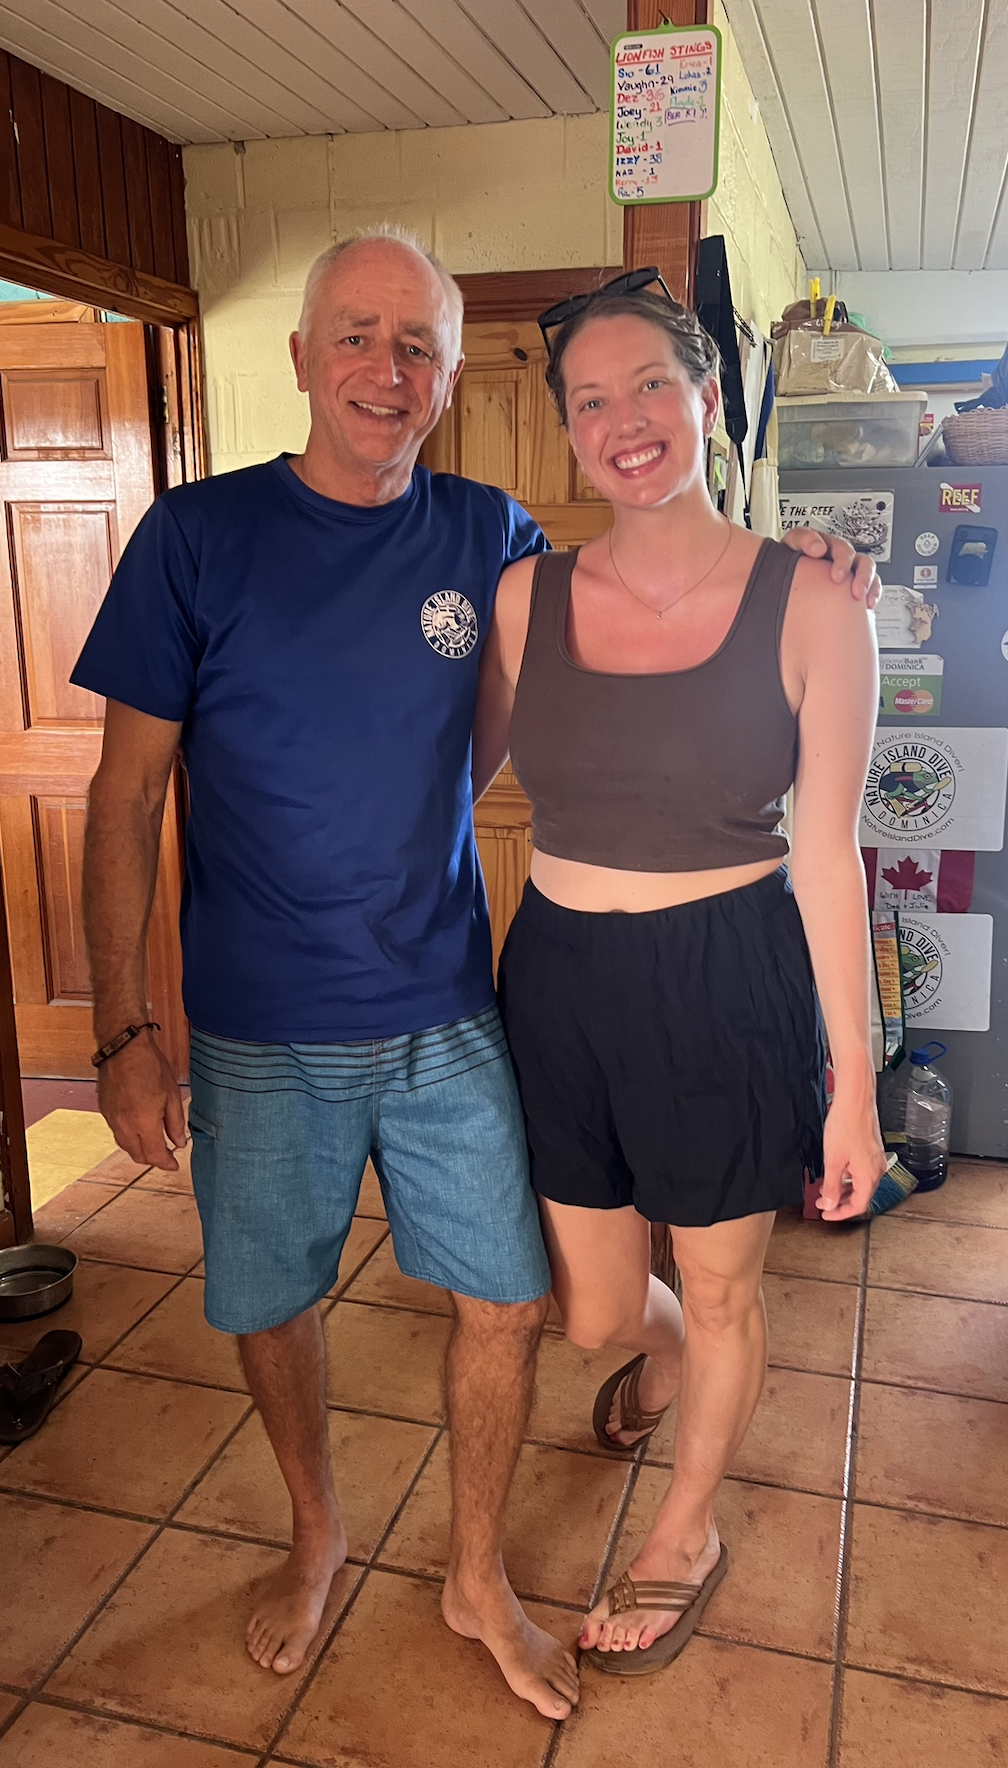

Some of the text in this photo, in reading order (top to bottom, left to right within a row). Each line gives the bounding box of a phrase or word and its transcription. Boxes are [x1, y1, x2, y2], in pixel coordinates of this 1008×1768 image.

[615, 41, 712, 63] LIONFISH STINGS
[942, 488, 980, 506] REEF
[789, 506, 808, 516] THE
[809, 506, 835, 516] REEF
[882, 675, 921, 689] Accept
[876, 732, 912, 748] Nature
[914, 732, 944, 747] Island
[865, 745, 952, 807] NATURE ISLAND DIVE
[878, 793, 953, 829] DOMINICA
[861, 815, 956, 842] NatureIslandDive.com
[901, 917, 931, 931] Island
[916, 937, 939, 962] DIVE
[905, 998, 943, 1020] Dive.com
